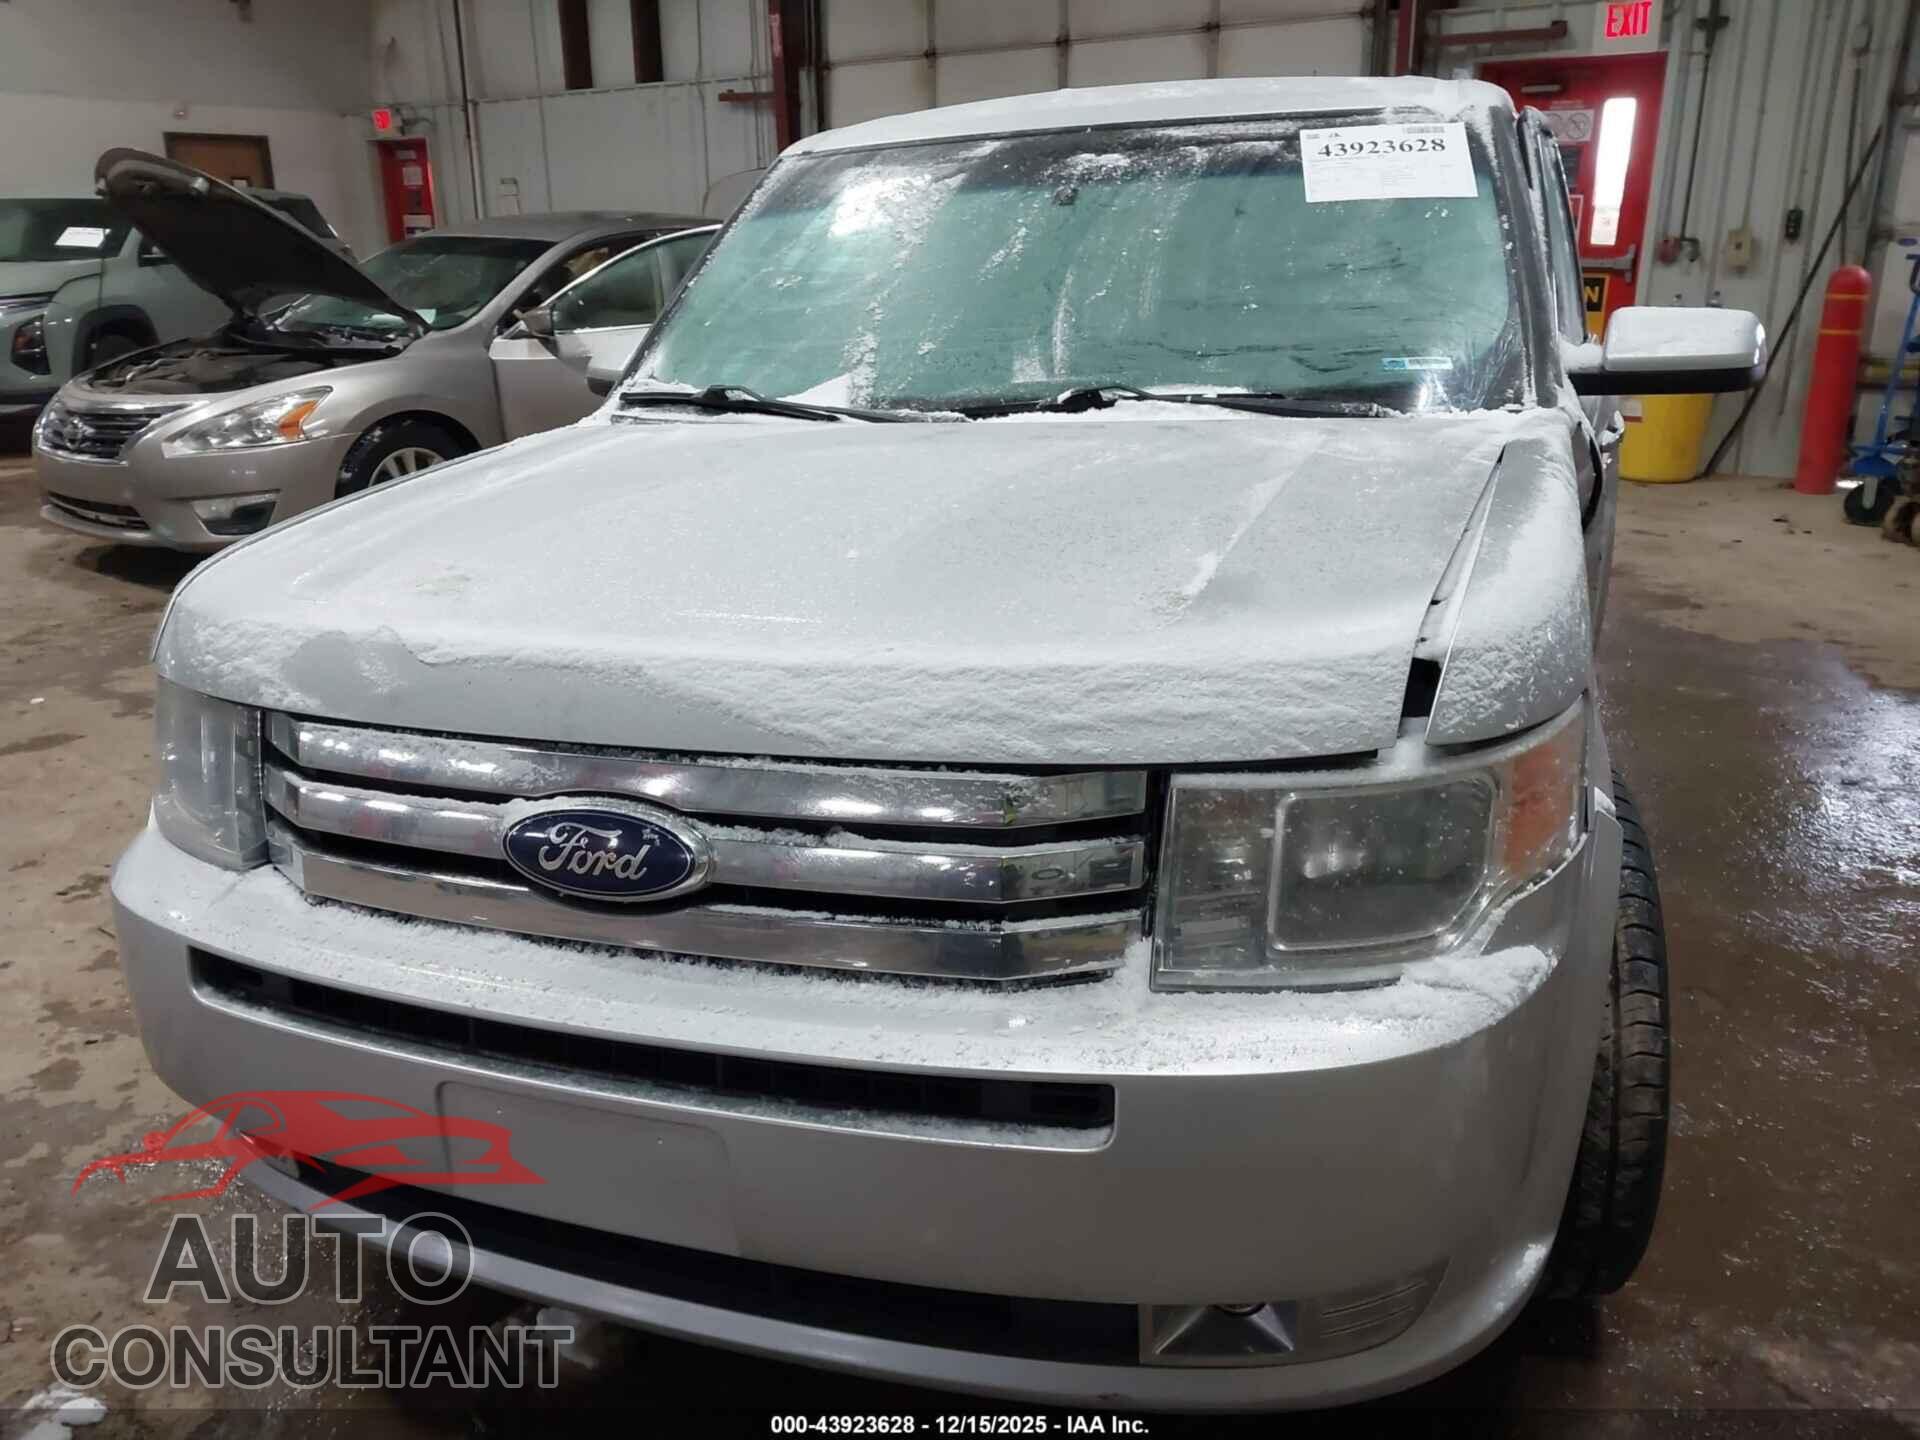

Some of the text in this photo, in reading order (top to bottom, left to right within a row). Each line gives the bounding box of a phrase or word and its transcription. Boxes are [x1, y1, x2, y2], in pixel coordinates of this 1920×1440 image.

[1606, 2, 1652, 37] EXIT
[1317, 138, 1446, 157] 43923628
[538, 822, 650, 880] Ford
